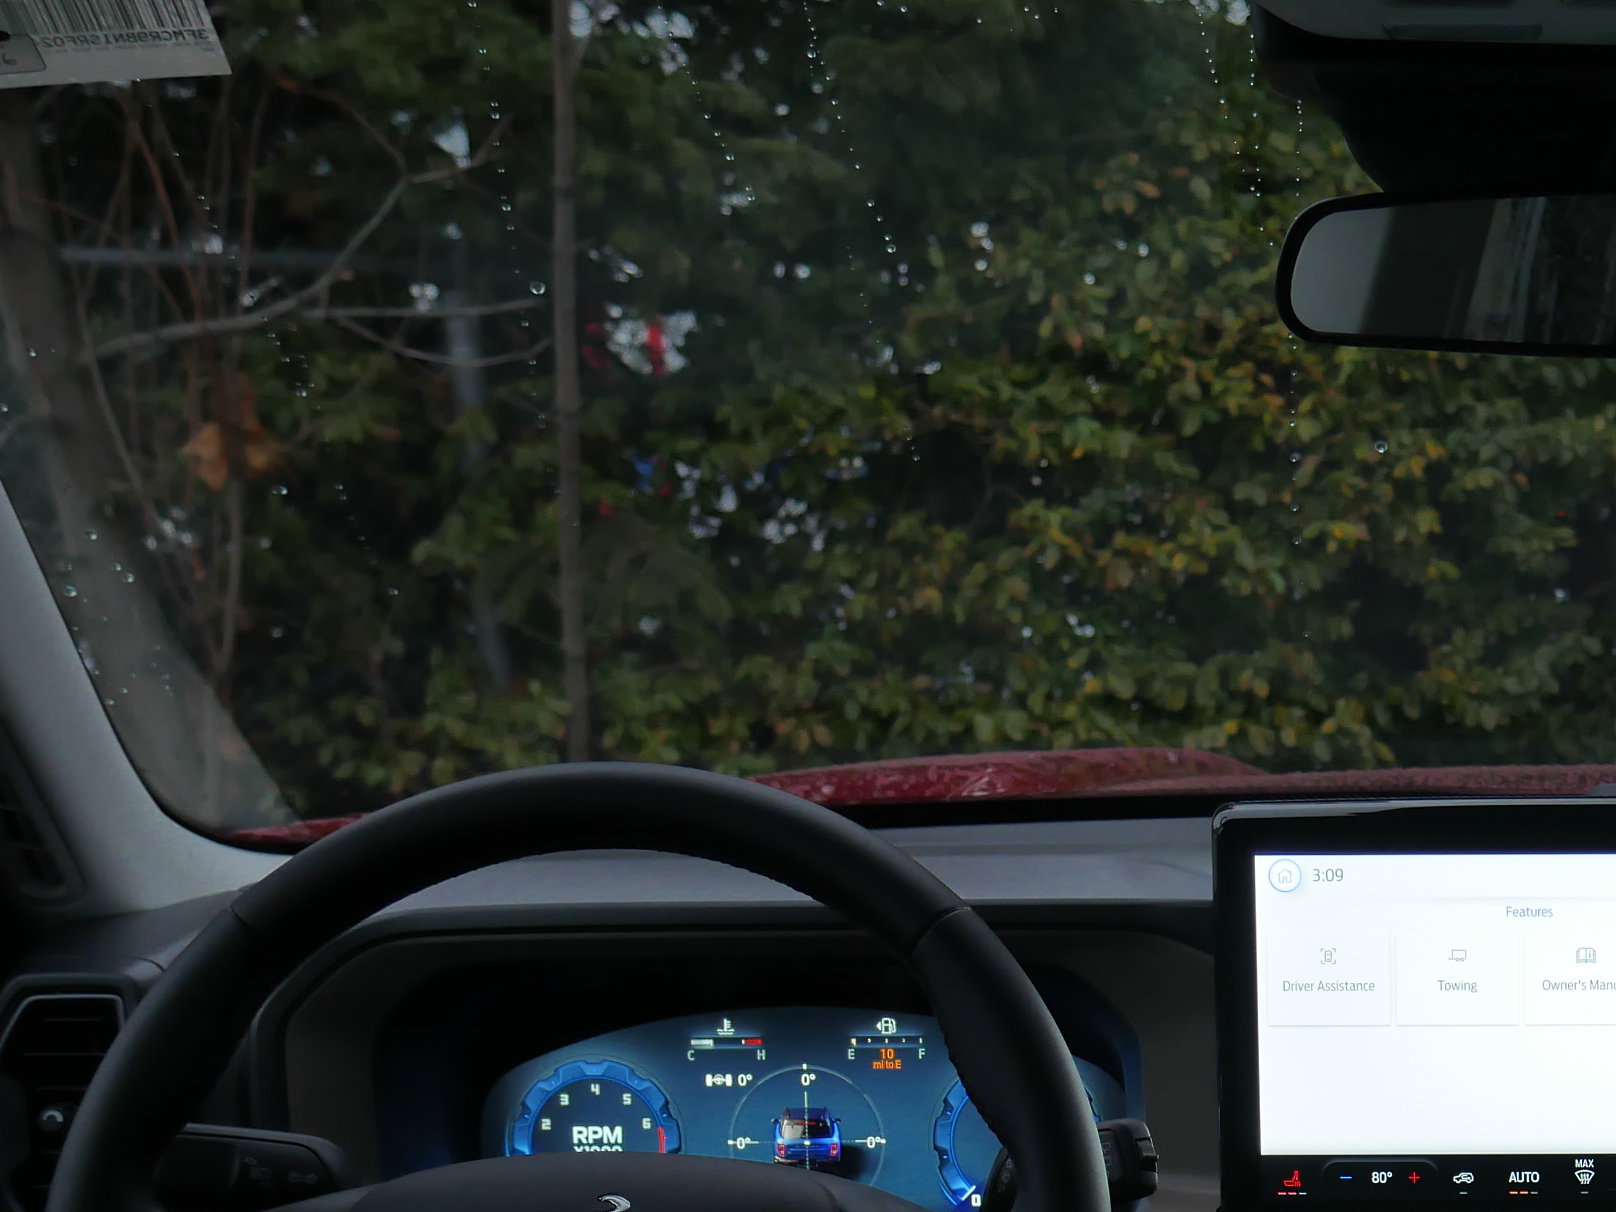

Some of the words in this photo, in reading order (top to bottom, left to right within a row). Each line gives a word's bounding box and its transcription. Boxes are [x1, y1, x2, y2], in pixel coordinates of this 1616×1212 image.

[1312, 868, 1344, 882] 3:09
[1506, 906, 1554, 918] Features
[1282, 980, 1314, 992] Driver
[1317, 980, 1375, 992] Assistance
[1438, 980, 1478, 993] Towing
[1542, 980, 1587, 991] Owner's
[687, 1050, 695, 1060] C
[756, 1050, 766, 1060] H
[848, 1048, 856, 1060] E
[880, 1048, 894, 1059] 10
[918, 1048, 926, 1060] F
[872, 1060, 884, 1069] mi
[884, 1060, 894, 1069] to
[895, 1060, 902, 1069] E
[737, 1074, 752, 1086] 0°
[801, 1073, 816, 1086] 0°
[590, 1084, 600, 1096] 4
[560, 1094, 570, 1106] 3
[622, 1093, 632, 1106] 5
[541, 1118, 552, 1130] 2
[642, 1118, 651, 1130] 6
[572, 1126, 623, 1144] RPM
[736, 1137, 751, 1150] 0°
[866, 1136, 881, 1148] 0°
[1574, 1158, 1594, 1168] MAX
[1371, 1171, 1392, 1184] 80°
[1508, 1172, 1540, 1183] AUTO
